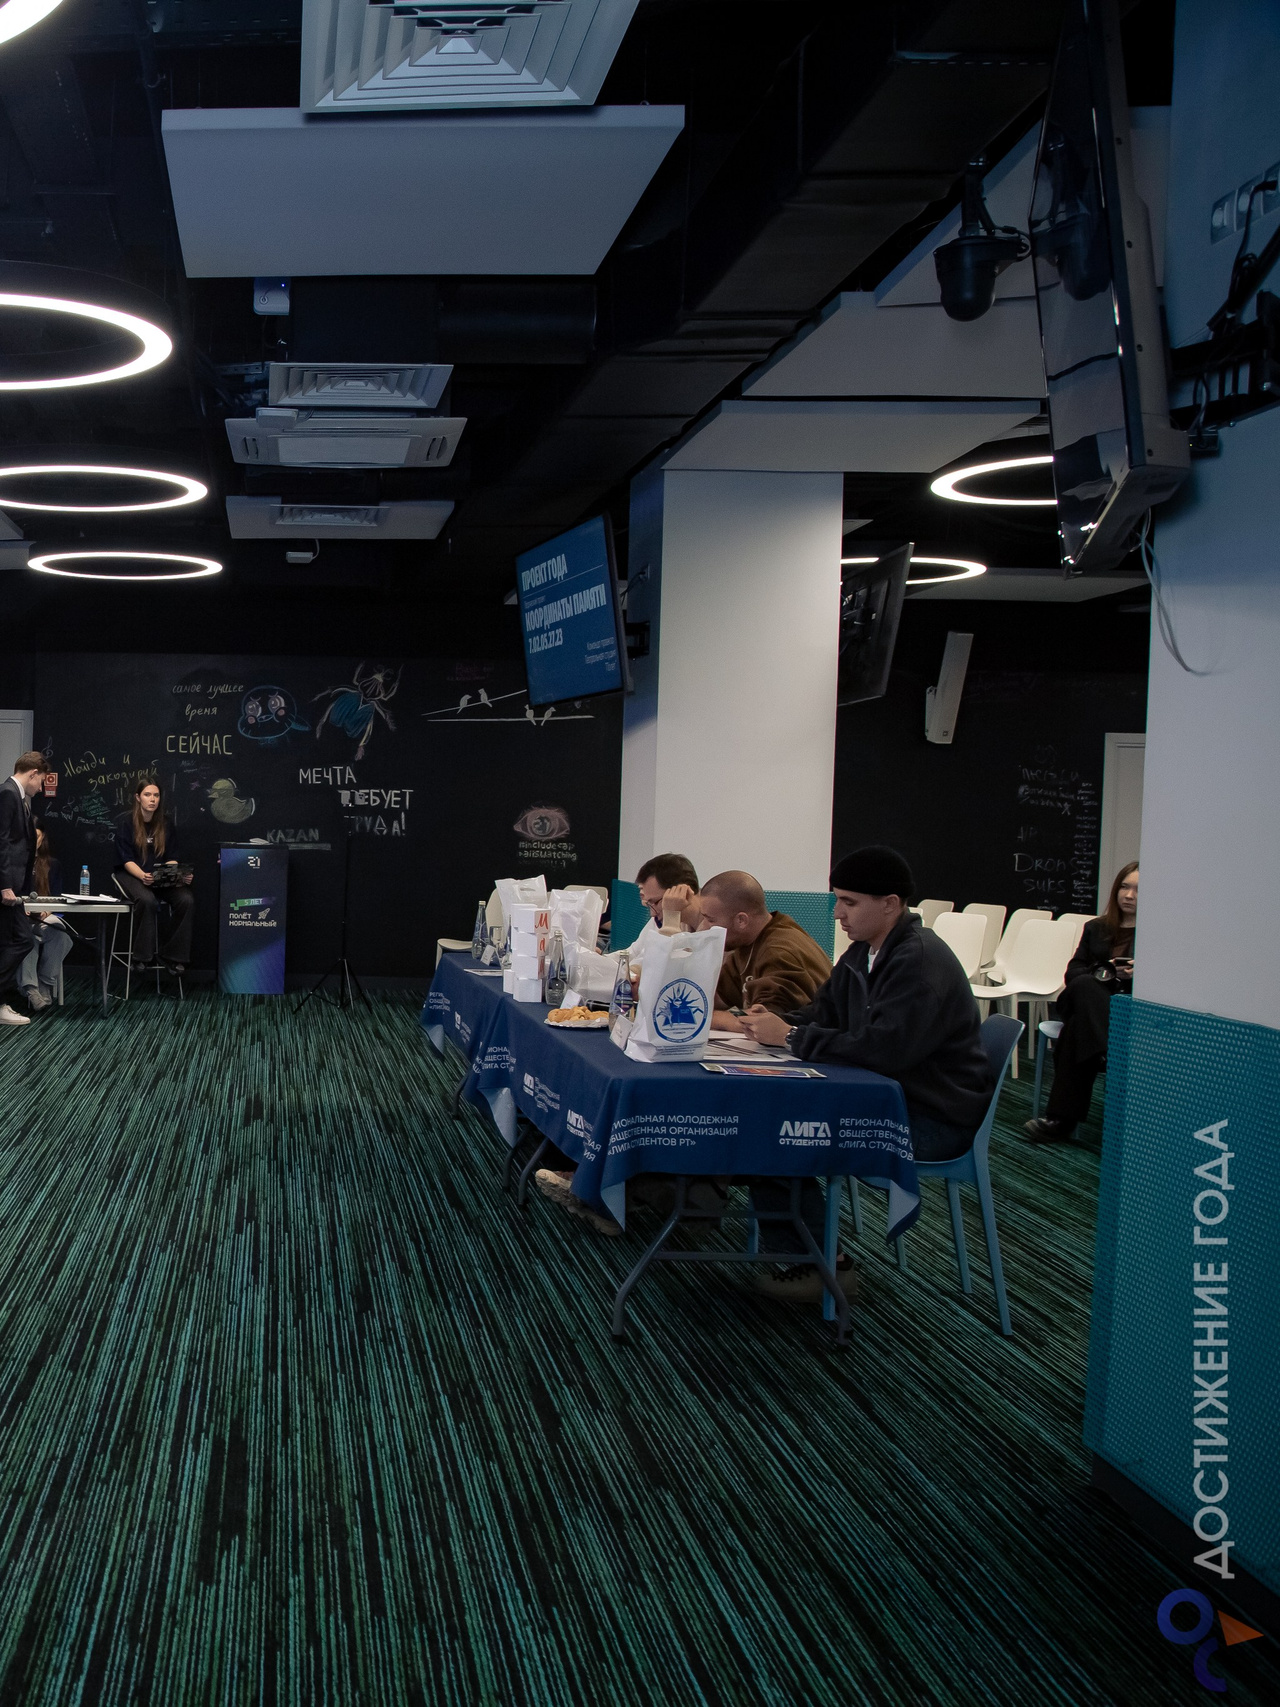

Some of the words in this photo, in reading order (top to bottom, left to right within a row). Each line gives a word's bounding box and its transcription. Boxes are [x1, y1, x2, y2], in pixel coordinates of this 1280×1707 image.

[521, 562, 548, 592] ПРОЕКТ
[547, 553, 568, 581] ГОДА
[525, 596, 574, 632] КООРДИНАТЫ
[573, 583, 607, 616] ПАМЯТИ
[172, 683, 202, 694] самое
[185, 704, 218, 722] время
[166, 731, 233, 756] СЕЙЧАС
[63, 750, 106, 777] Найди
[299, 766, 357, 785] МЕЧТА
[267, 828, 320, 843] KAZAN
[667, 1115, 739, 1125] МОЛОДЕЖНАЯ
[669, 1126, 738, 1136] ОРГАНИЗАЦИЯ
[779, 1120, 832, 1138] ЛИГА
[679, 1138, 697, 1147] РТ»
[779, 1138, 831, 1147] СТУДЕНТОВ
[838, 1140, 866, 1149] «ЛИГА
